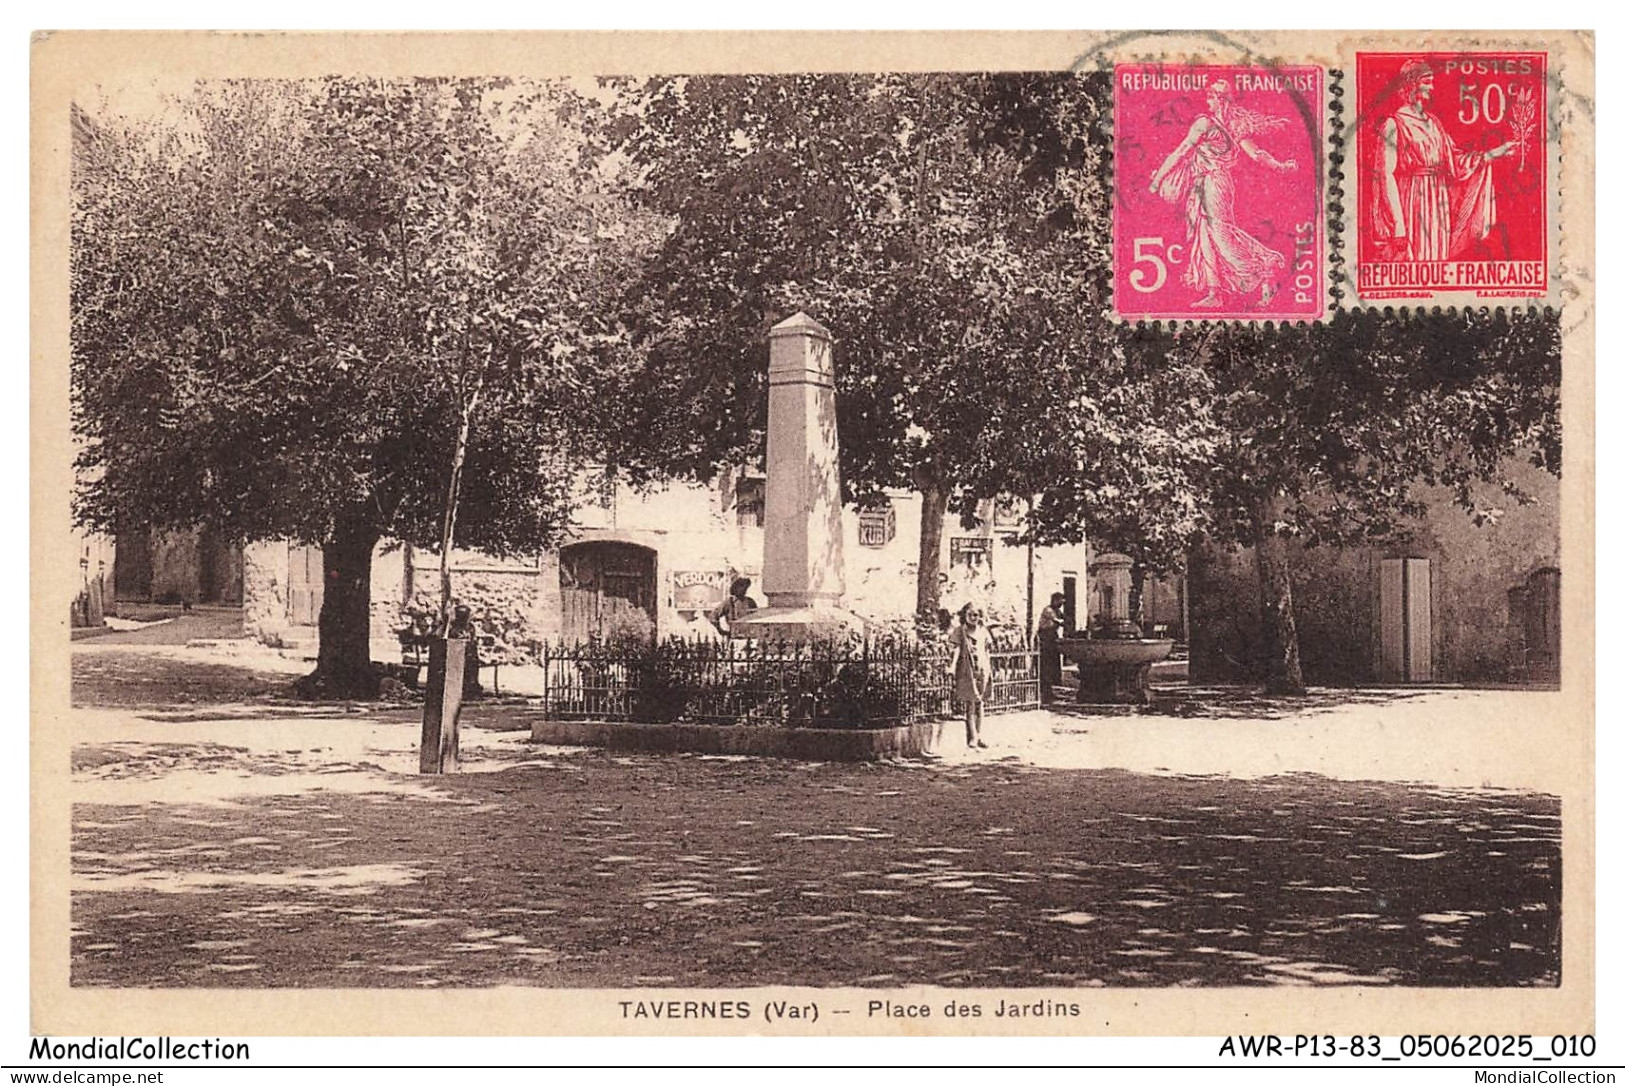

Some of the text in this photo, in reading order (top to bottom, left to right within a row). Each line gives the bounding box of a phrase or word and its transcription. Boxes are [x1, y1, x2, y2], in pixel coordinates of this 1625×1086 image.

[1445, 60, 1532, 75] POSTES
[1295, 222, 1313, 303] POSTES
[861, 527, 884, 544] KUB
[618, 1000, 1081, 1022] TAVERNES (Var) Place des Jardins
